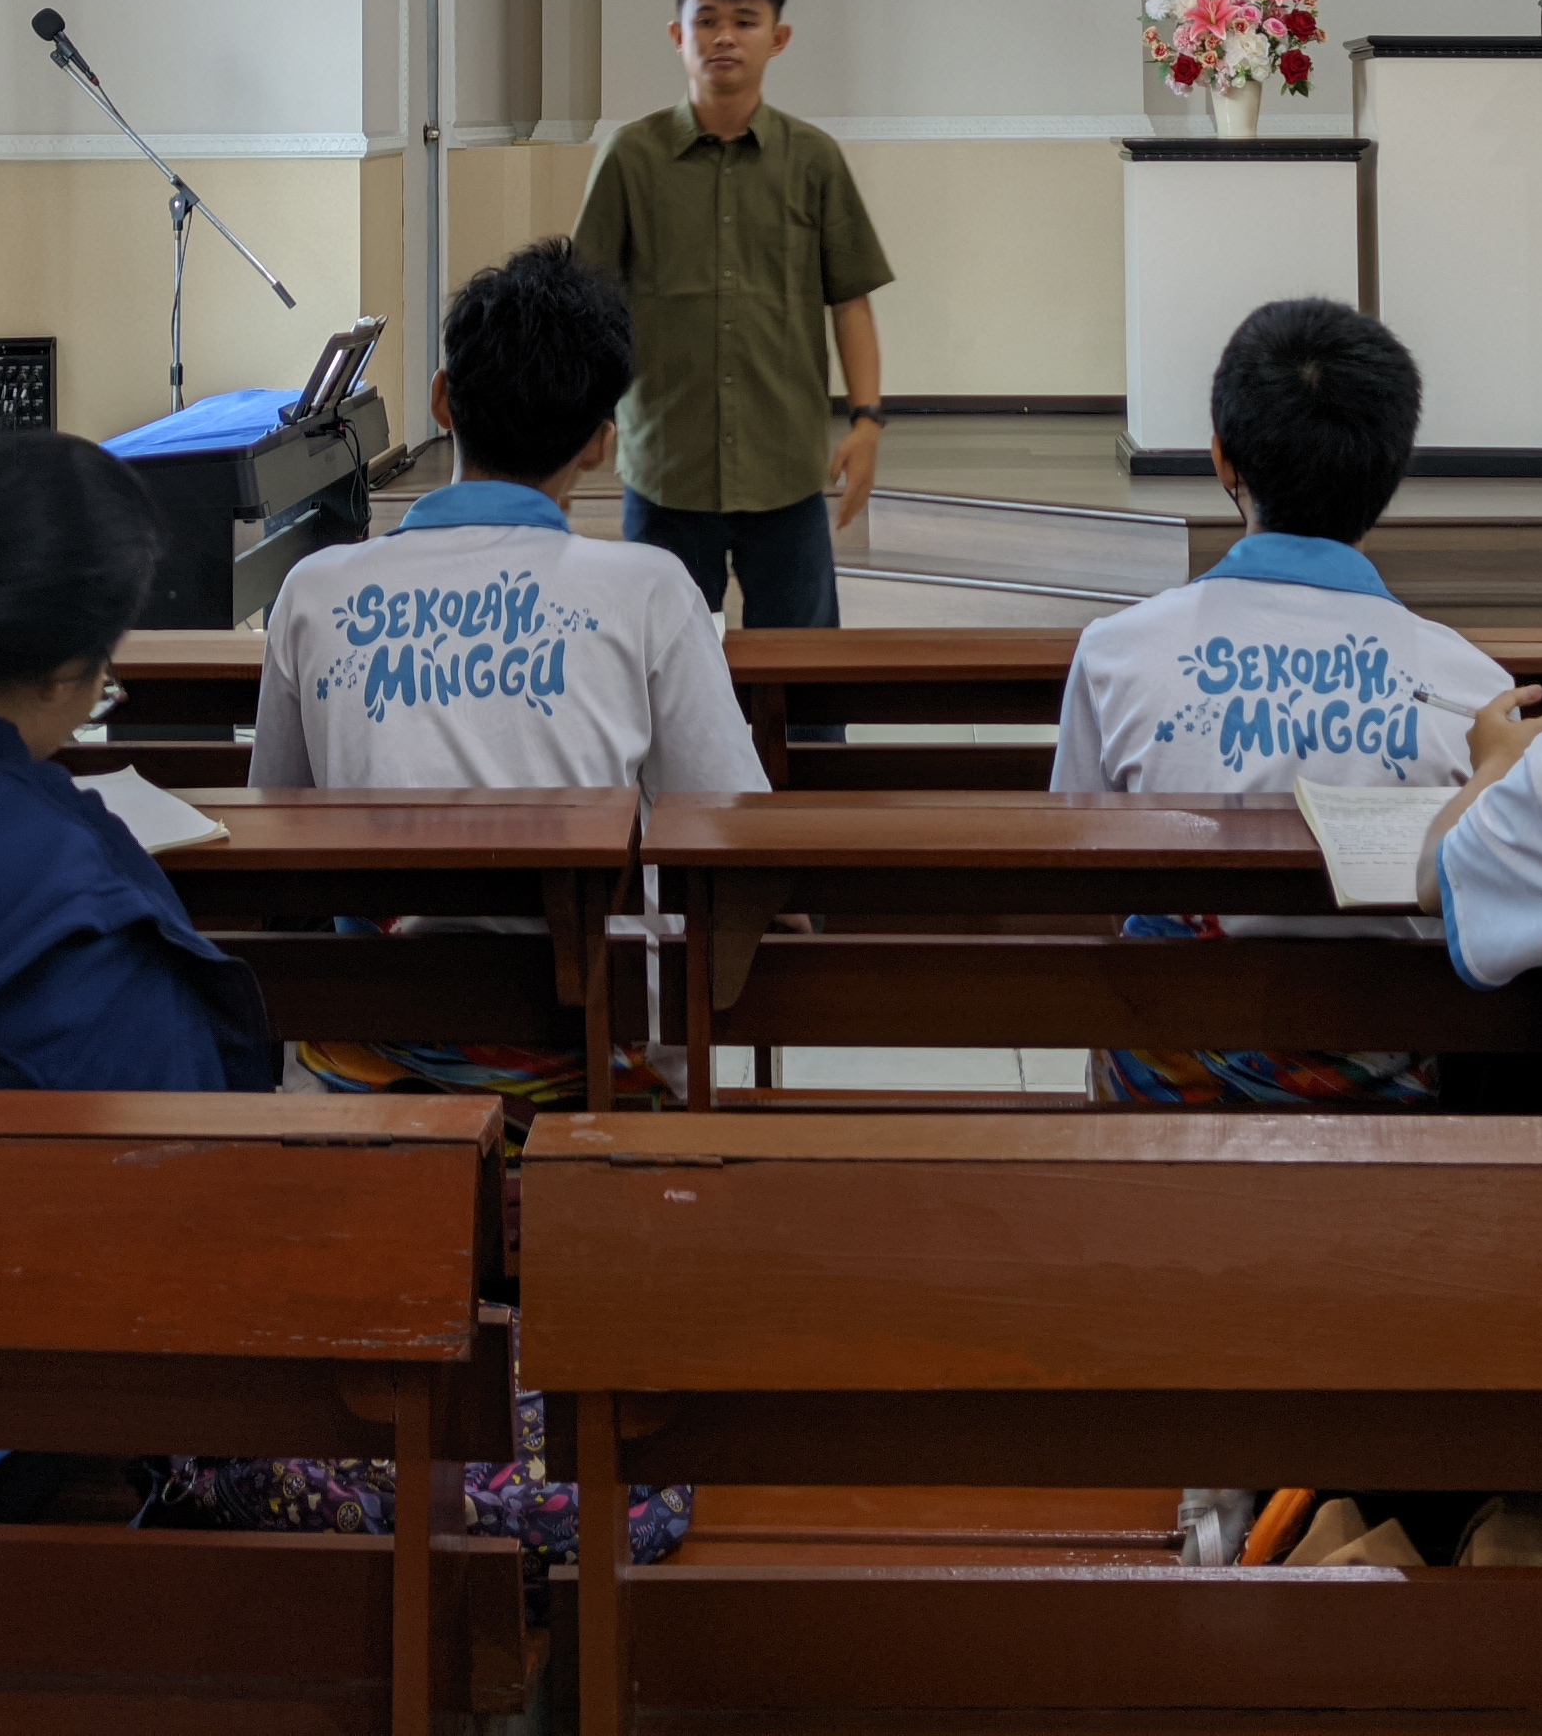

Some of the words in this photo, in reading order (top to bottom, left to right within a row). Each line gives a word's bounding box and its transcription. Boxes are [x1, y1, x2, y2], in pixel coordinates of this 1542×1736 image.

[346, 582, 541, 646] SEKOLAH
[363, 639, 566, 707] MINGGU
[1197, 636, 1390, 703] SEKOLAH
[1219, 695, 1419, 761] MINGGU
